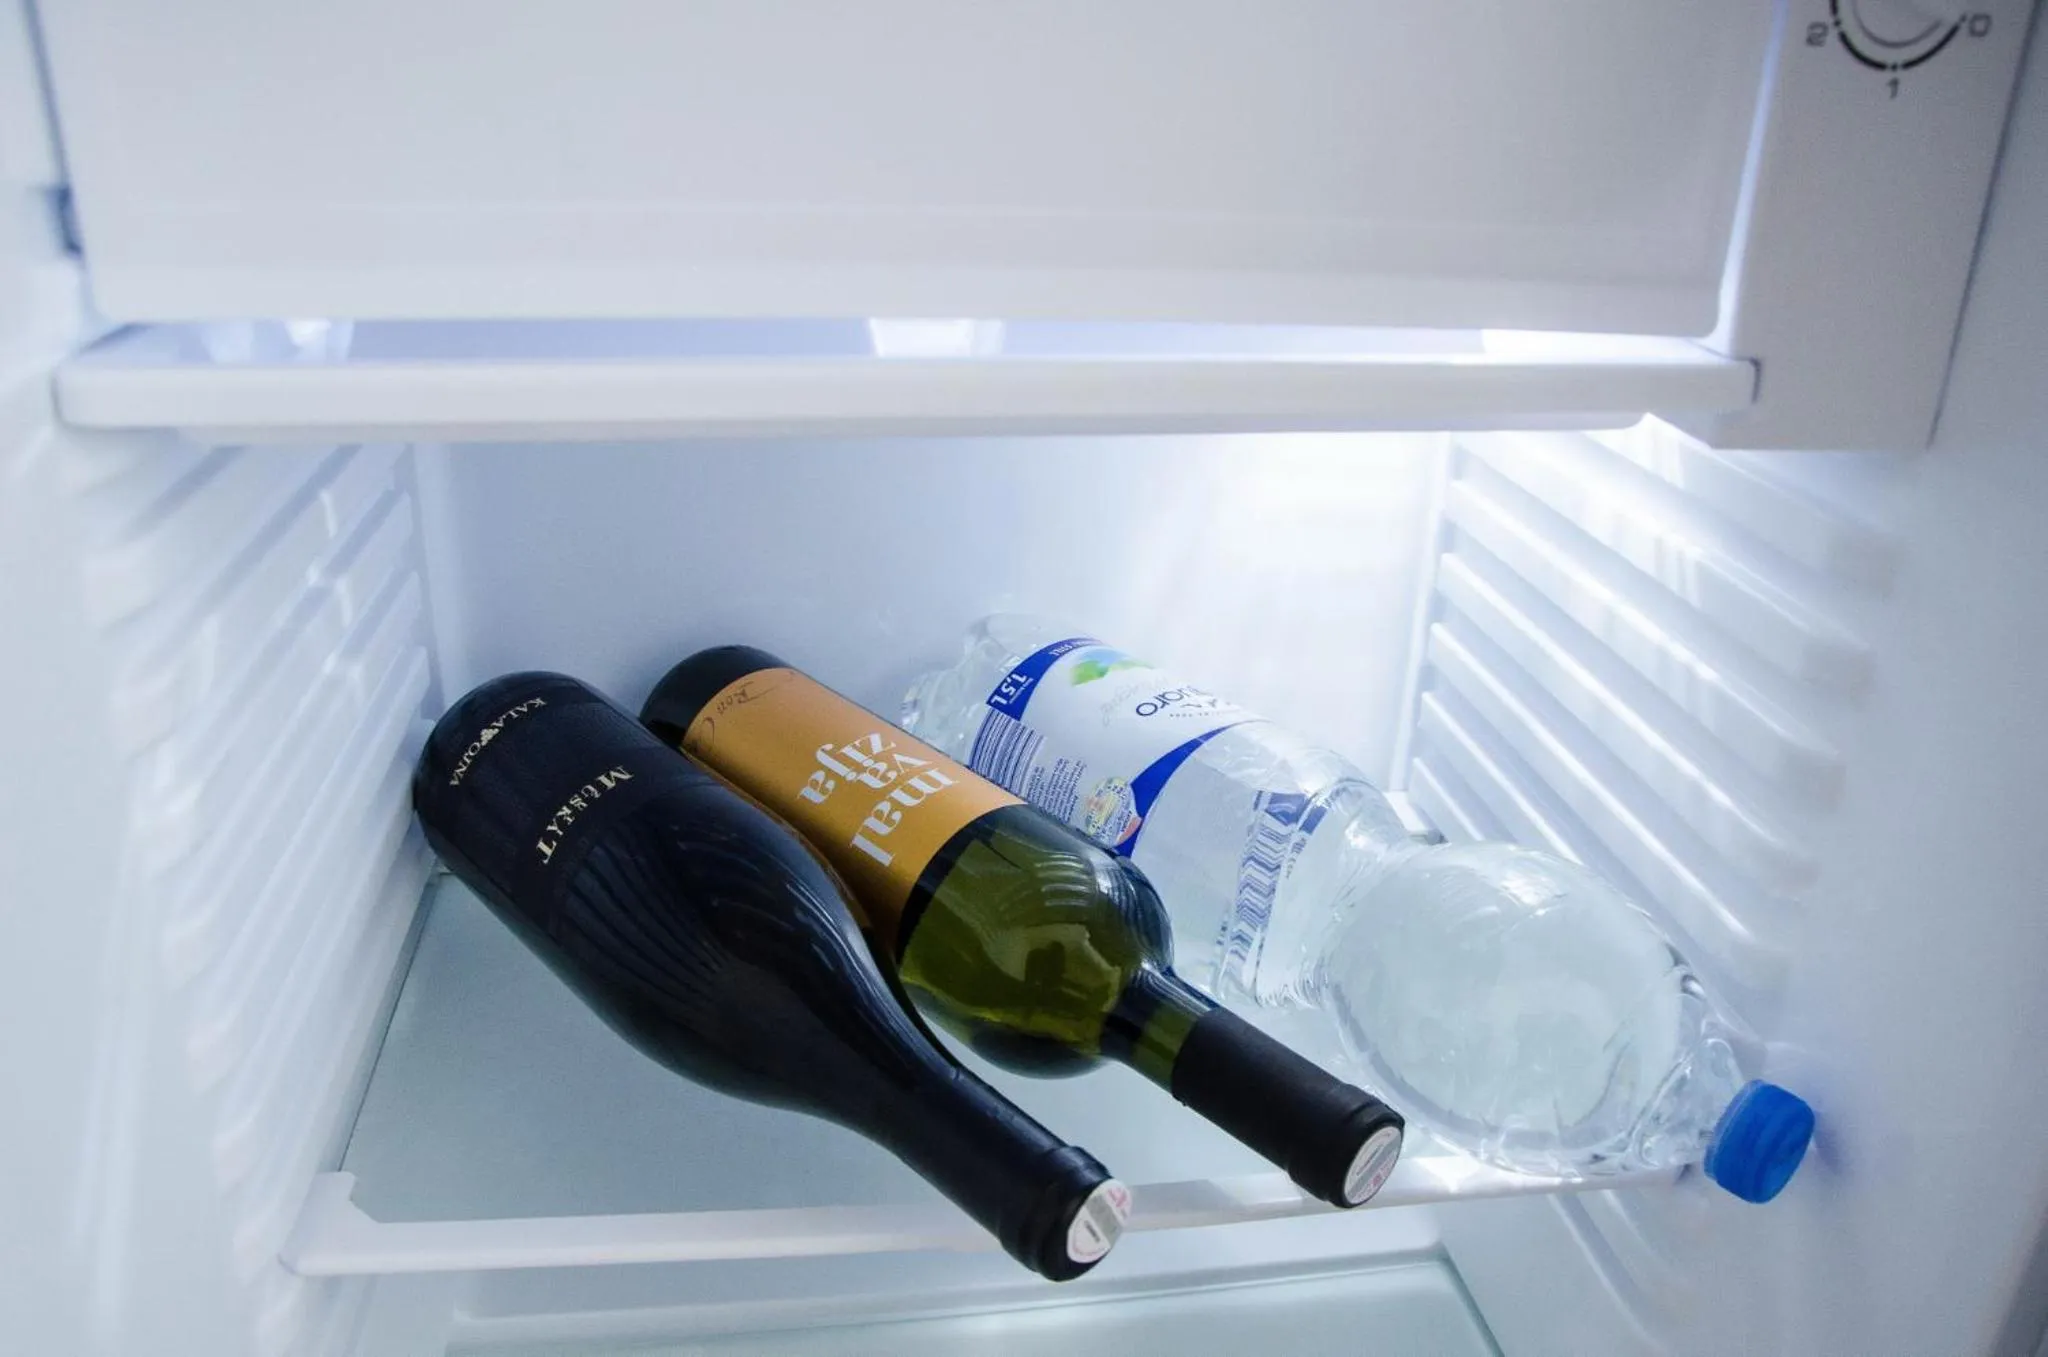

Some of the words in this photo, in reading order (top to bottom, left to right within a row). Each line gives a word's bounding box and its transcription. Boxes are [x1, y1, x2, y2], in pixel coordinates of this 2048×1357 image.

[1886, 77, 1899, 99] 1
[1002, 672, 1027, 697] 1,5
[851, 768, 960, 867] mal
